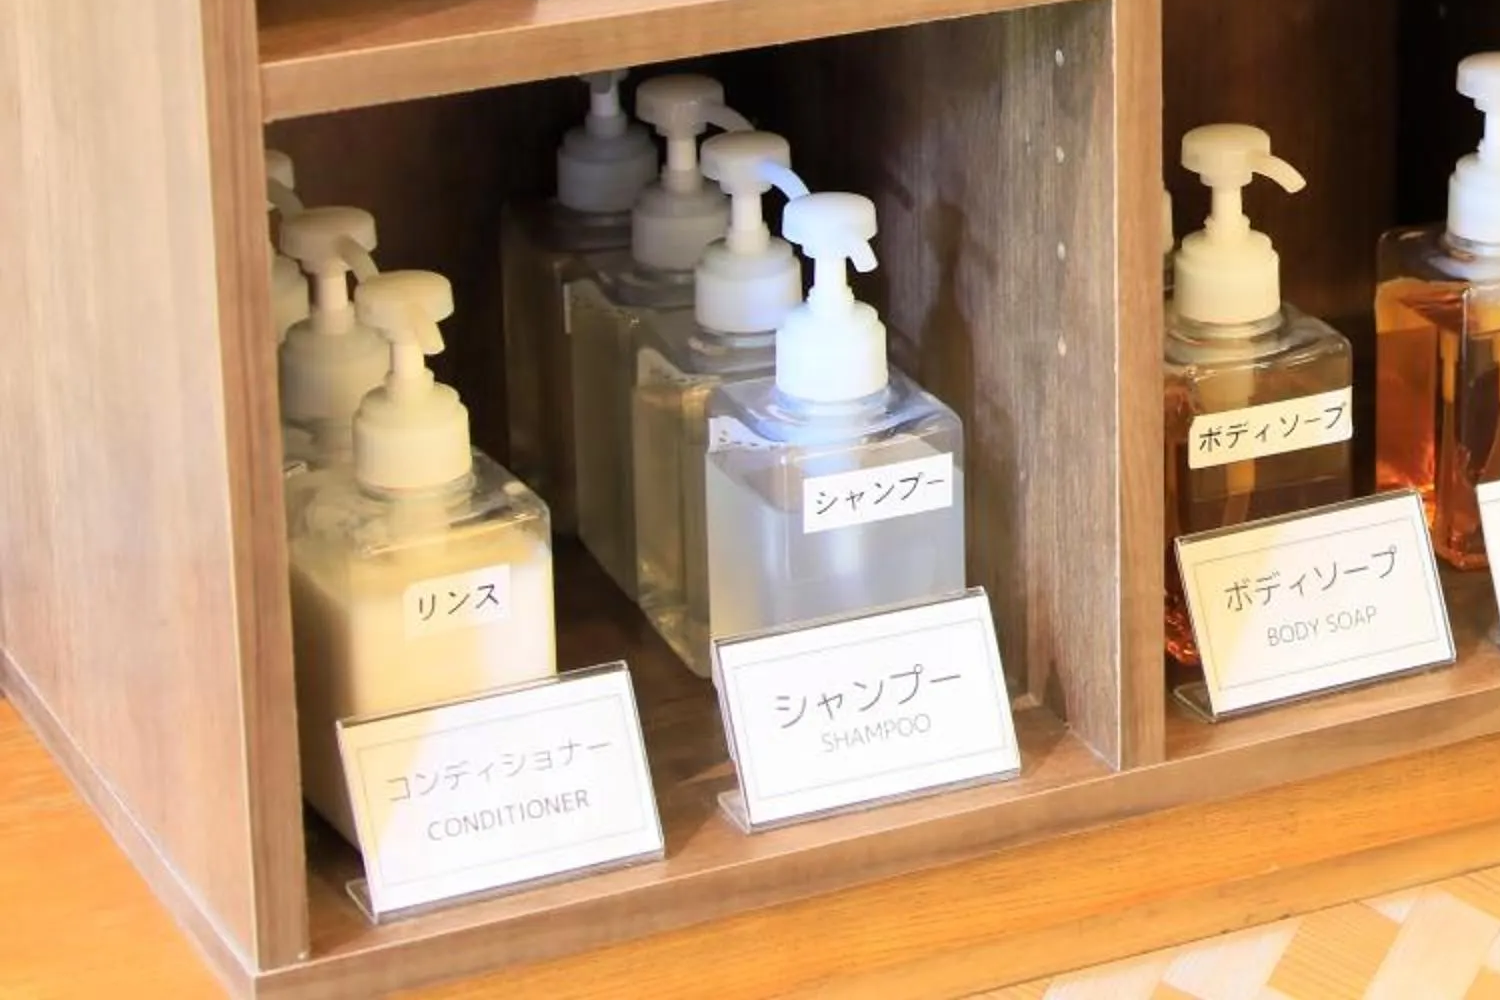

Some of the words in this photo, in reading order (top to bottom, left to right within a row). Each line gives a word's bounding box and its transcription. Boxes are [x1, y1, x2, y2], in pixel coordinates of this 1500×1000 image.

[816, 471, 946, 516] シャンプー
[418, 583, 500, 621] リンス
[1223, 544, 1398, 613] ボディソープ
[1266, 617, 1320, 648] BODY
[1326, 605, 1378, 633] SOAP
[775, 663, 961, 729] シャンプー
[821, 713, 932, 752] SHAMPOO
[386, 738, 613, 802] コンディショナー
[426, 789, 591, 841] CONDITIONER
